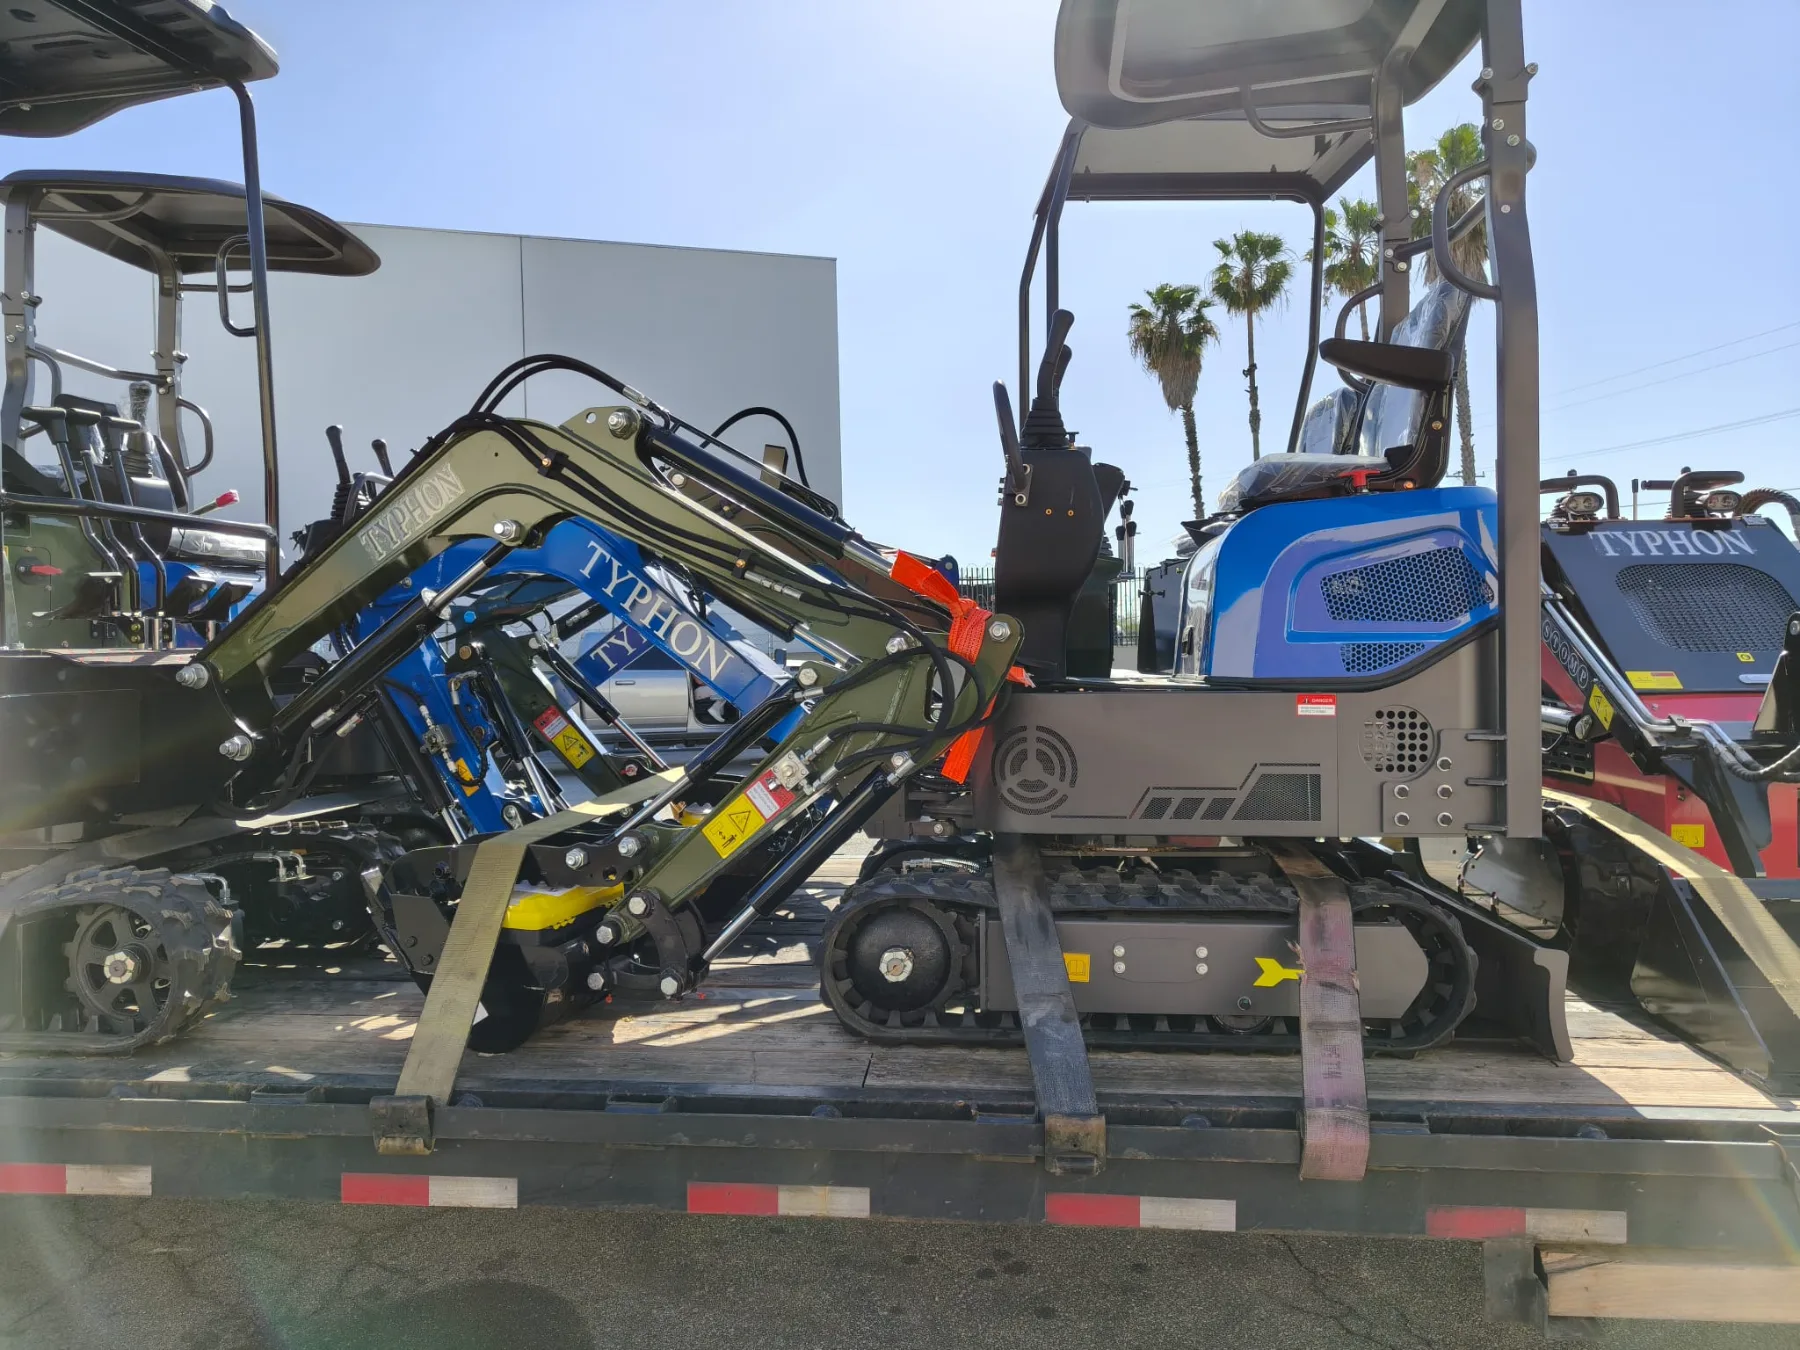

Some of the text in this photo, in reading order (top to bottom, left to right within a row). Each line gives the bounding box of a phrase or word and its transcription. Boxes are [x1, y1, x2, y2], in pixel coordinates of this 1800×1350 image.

[360, 462, 466, 560] TYPHON
[1588, 529, 1757, 556] TYPHON
[579, 540, 734, 681] TYPHON
[1542, 621, 1588, 687] STOMP
